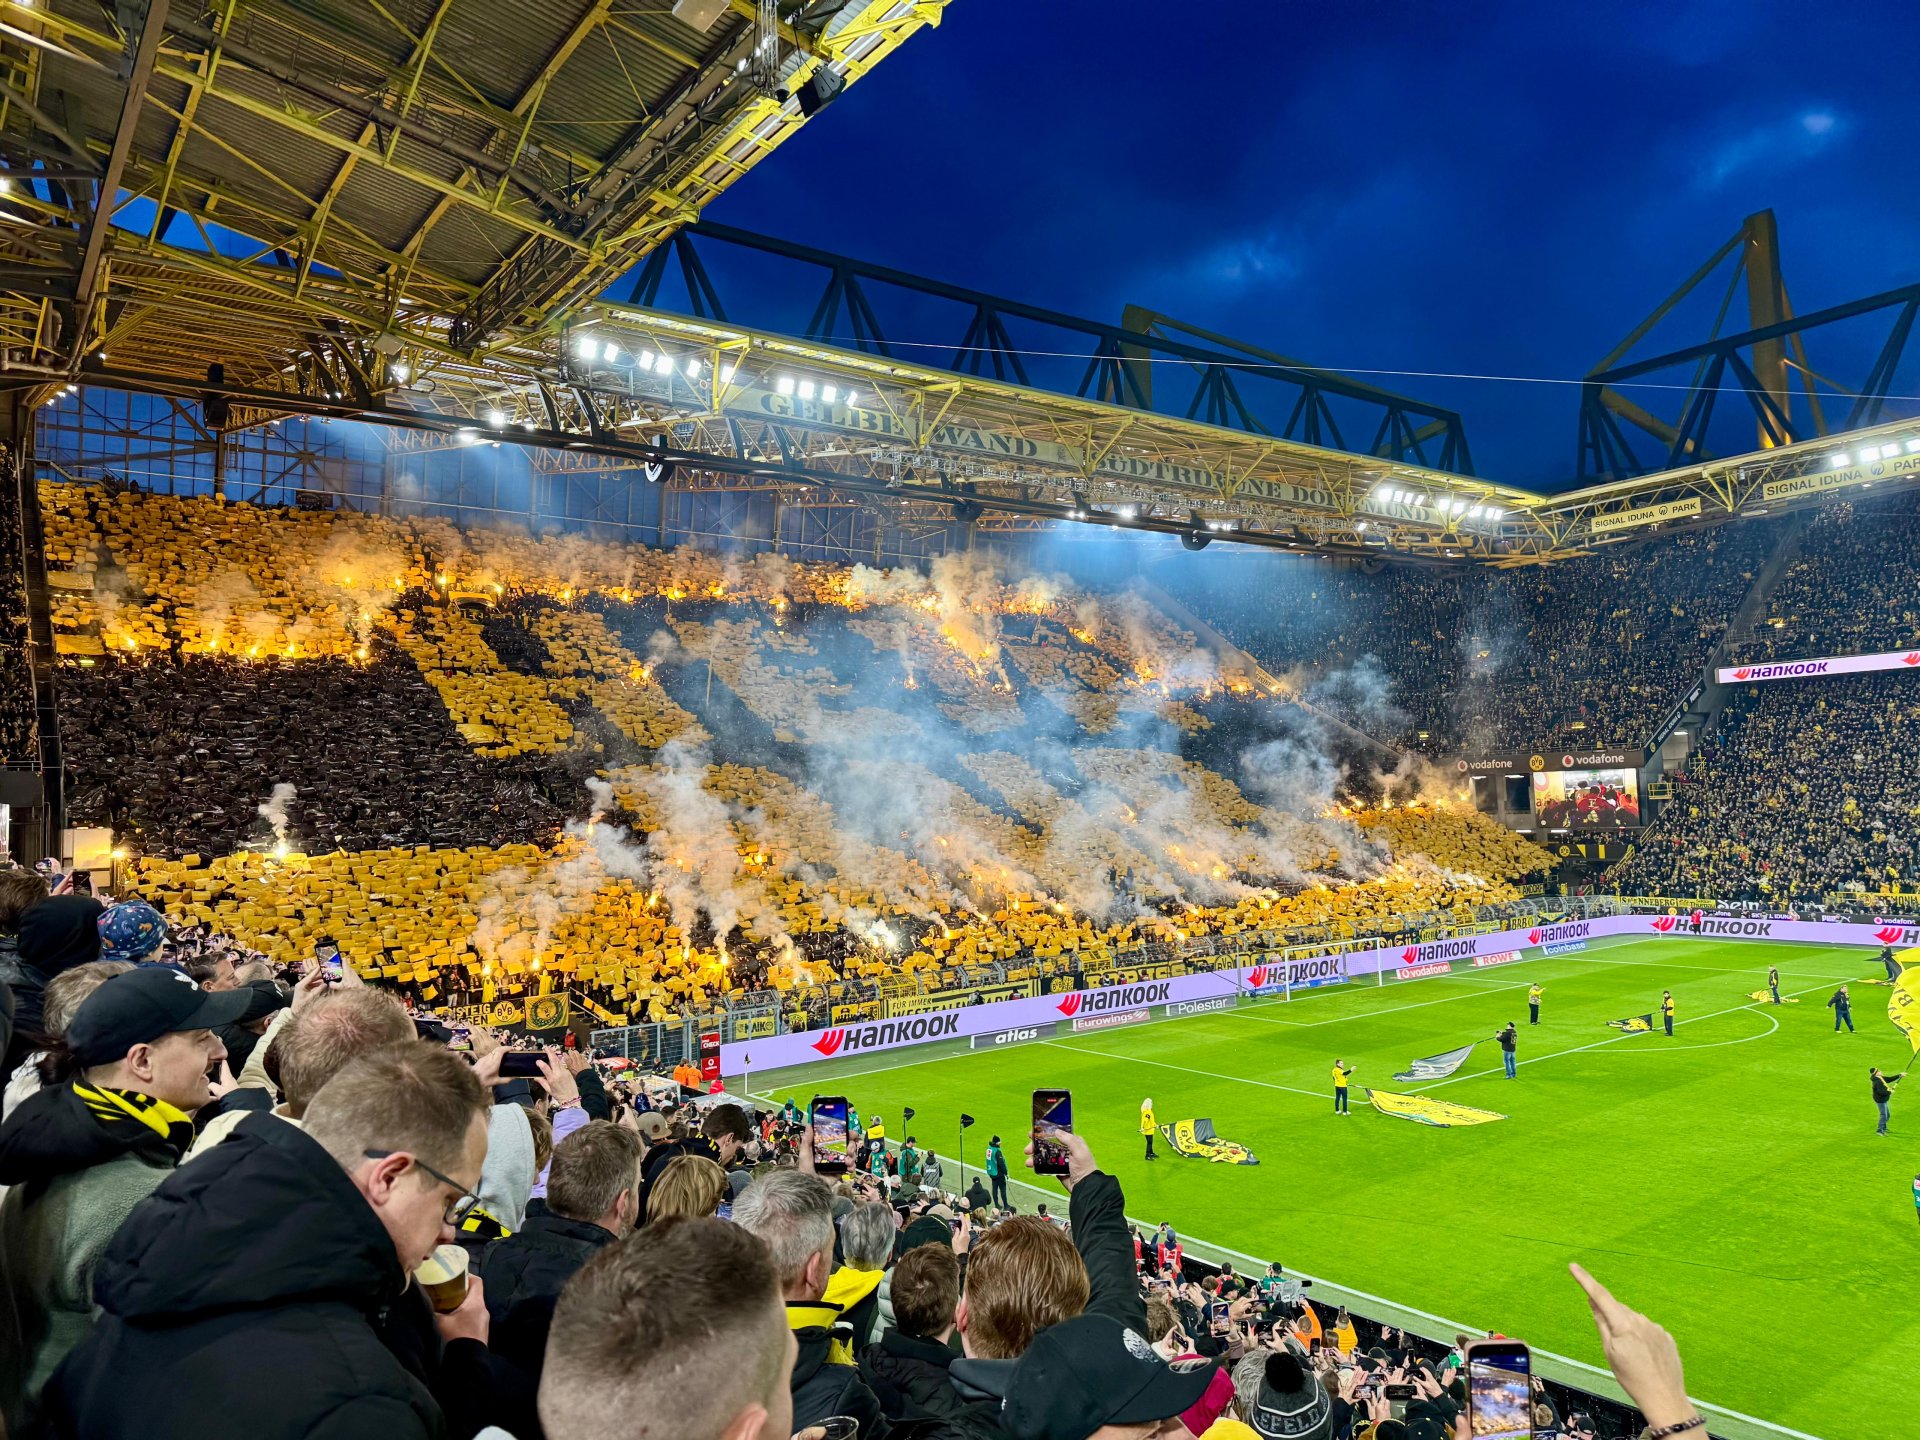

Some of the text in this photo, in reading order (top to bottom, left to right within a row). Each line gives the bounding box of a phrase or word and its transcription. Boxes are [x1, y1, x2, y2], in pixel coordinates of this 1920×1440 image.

[761, 393, 1038, 457] GELBE WAND
[1767, 480, 1815, 496] SIGNAL
[1820, 470, 1863, 486] IDUNA
[1595, 502, 1697, 528] SIGNAL IDUNA PARK
[1470, 759, 1513, 770] vodafone
[1576, 753, 1624, 764] vodafone
[1547, 941, 1586, 953] coinbase
[1483, 952, 1515, 965] ROWE
[1411, 963, 1449, 976] vodafone
[497, 1003, 513, 1017] BVB
[892, 997, 933, 1010] FÜR IMMER
[1178, 997, 1228, 1015] Polestar
[1077, 1011, 1133, 1029] Eurowings
[995, 1027, 1037, 1045] atlas
